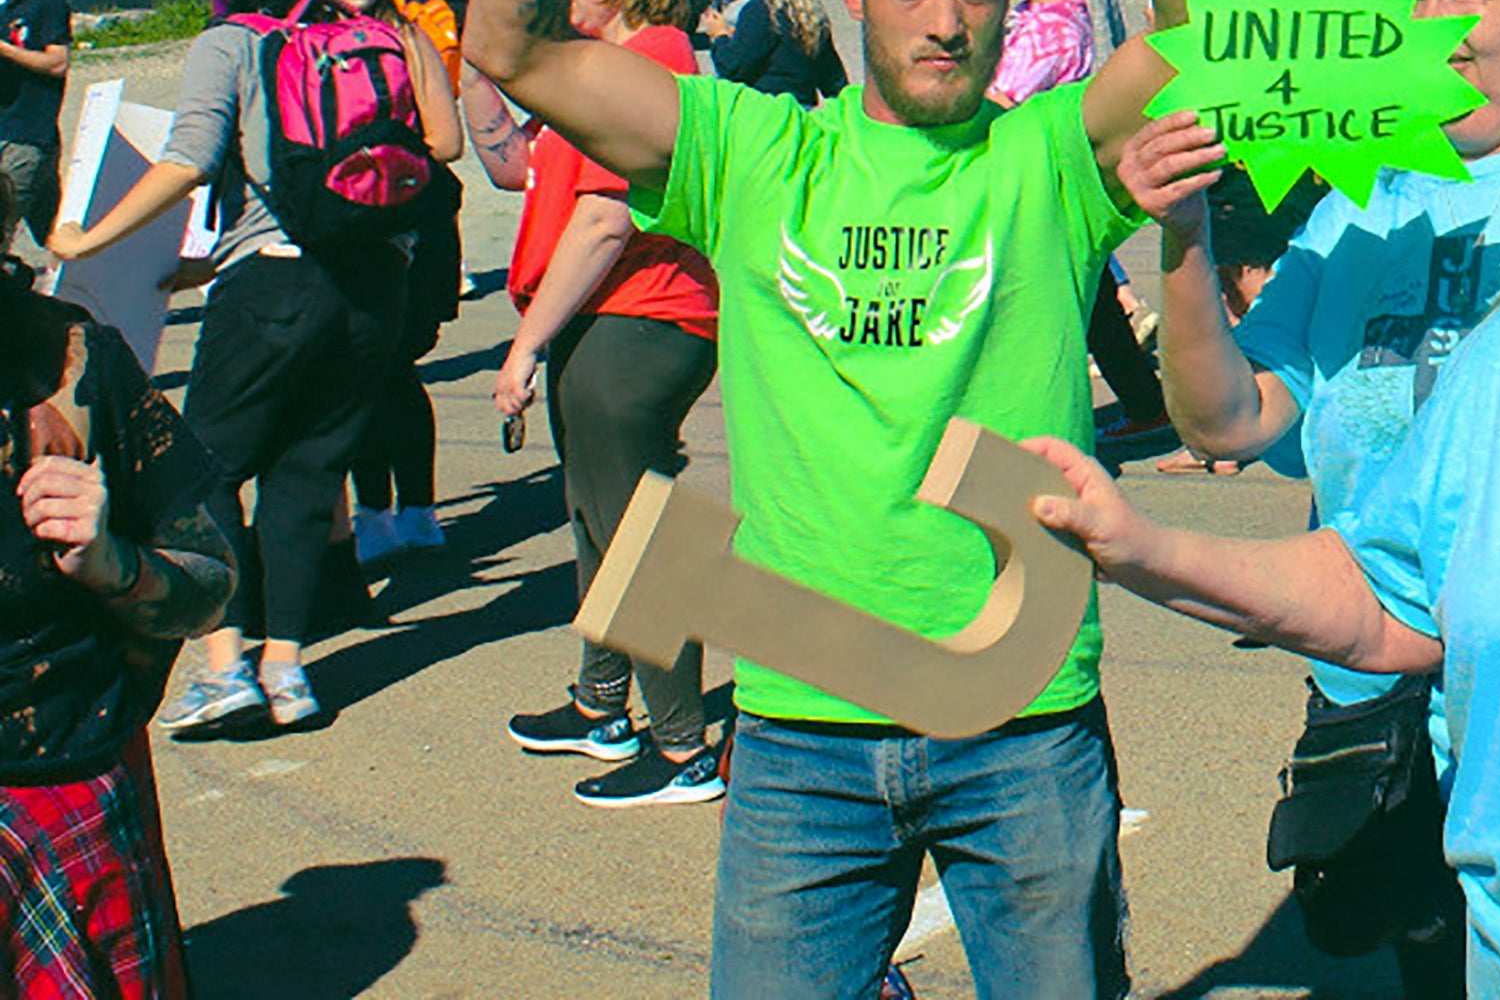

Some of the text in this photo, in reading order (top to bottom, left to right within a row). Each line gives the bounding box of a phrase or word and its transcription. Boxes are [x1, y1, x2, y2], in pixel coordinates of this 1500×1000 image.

[1204, 7, 1404, 63] UNITED
[1265, 68, 1301, 106] 4
[1199, 102, 1404, 143] JUSTICE
[838, 226, 950, 270] JUSTICE
[839, 296, 927, 348] JAKE
